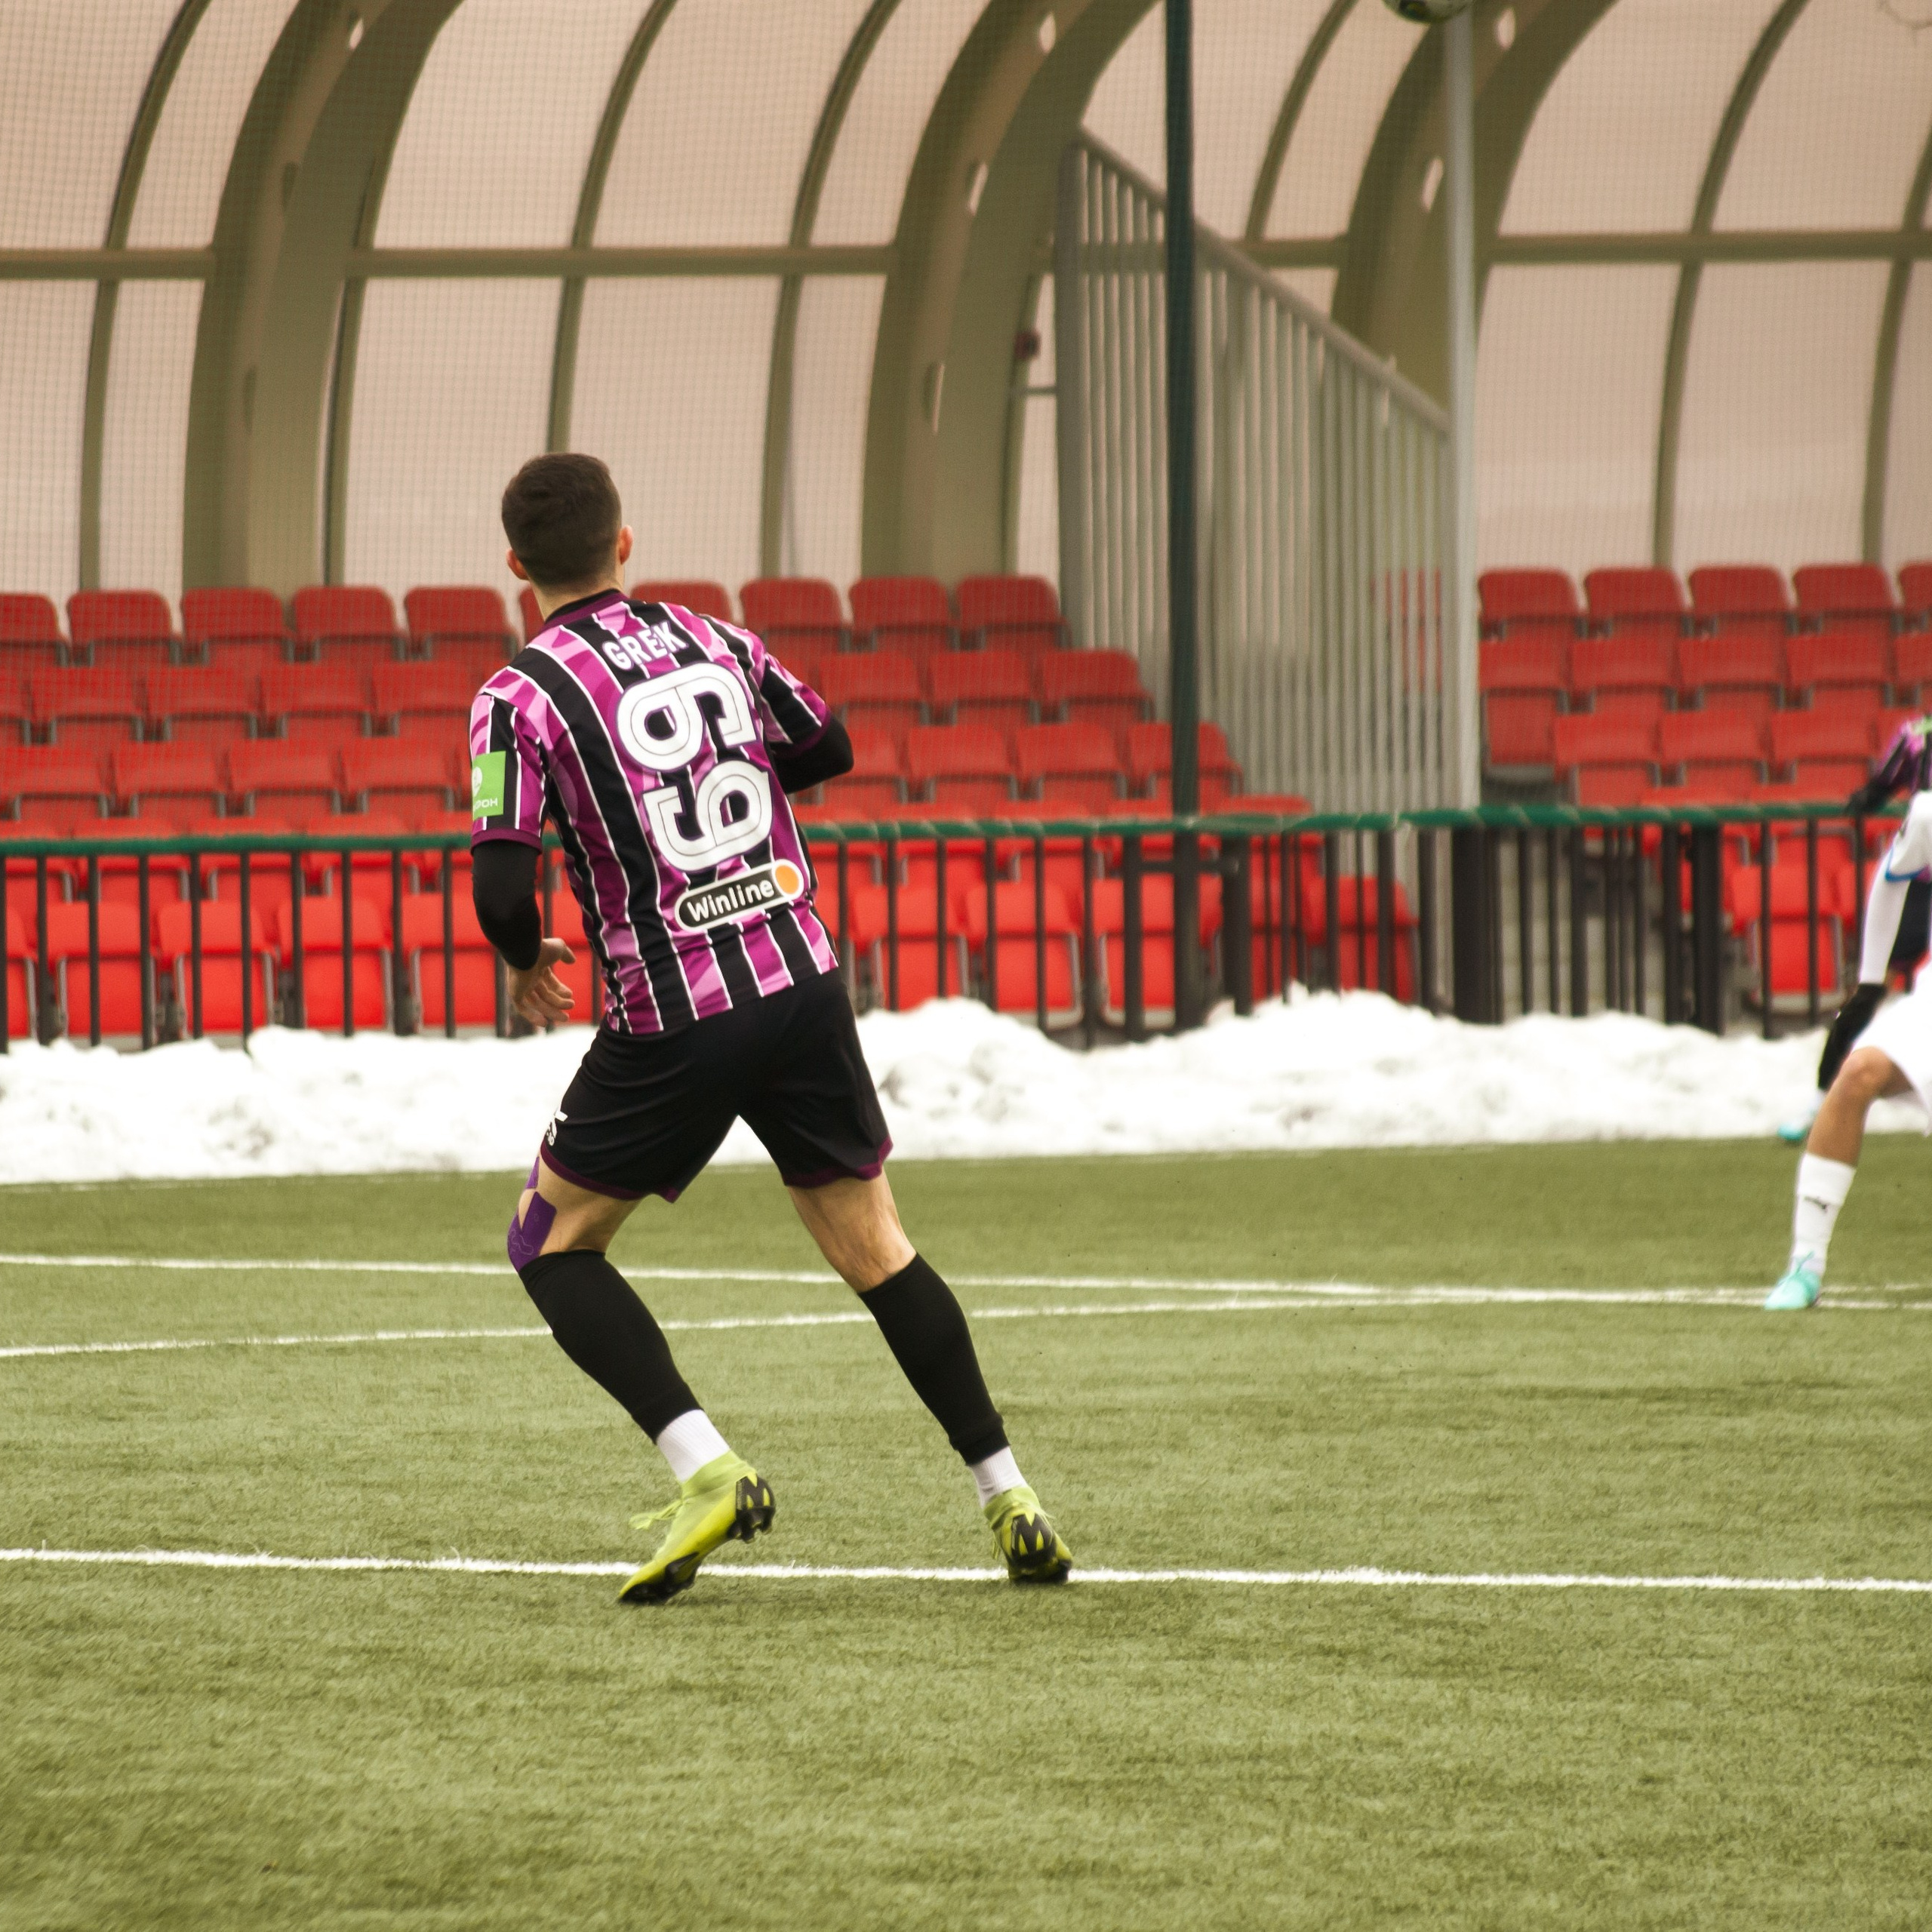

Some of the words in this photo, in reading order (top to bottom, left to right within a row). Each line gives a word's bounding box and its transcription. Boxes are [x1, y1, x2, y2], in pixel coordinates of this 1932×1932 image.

[603, 620, 688, 671] GREK
[472, 797, 498, 812] ФОН
[686, 879, 775, 922] Winline
